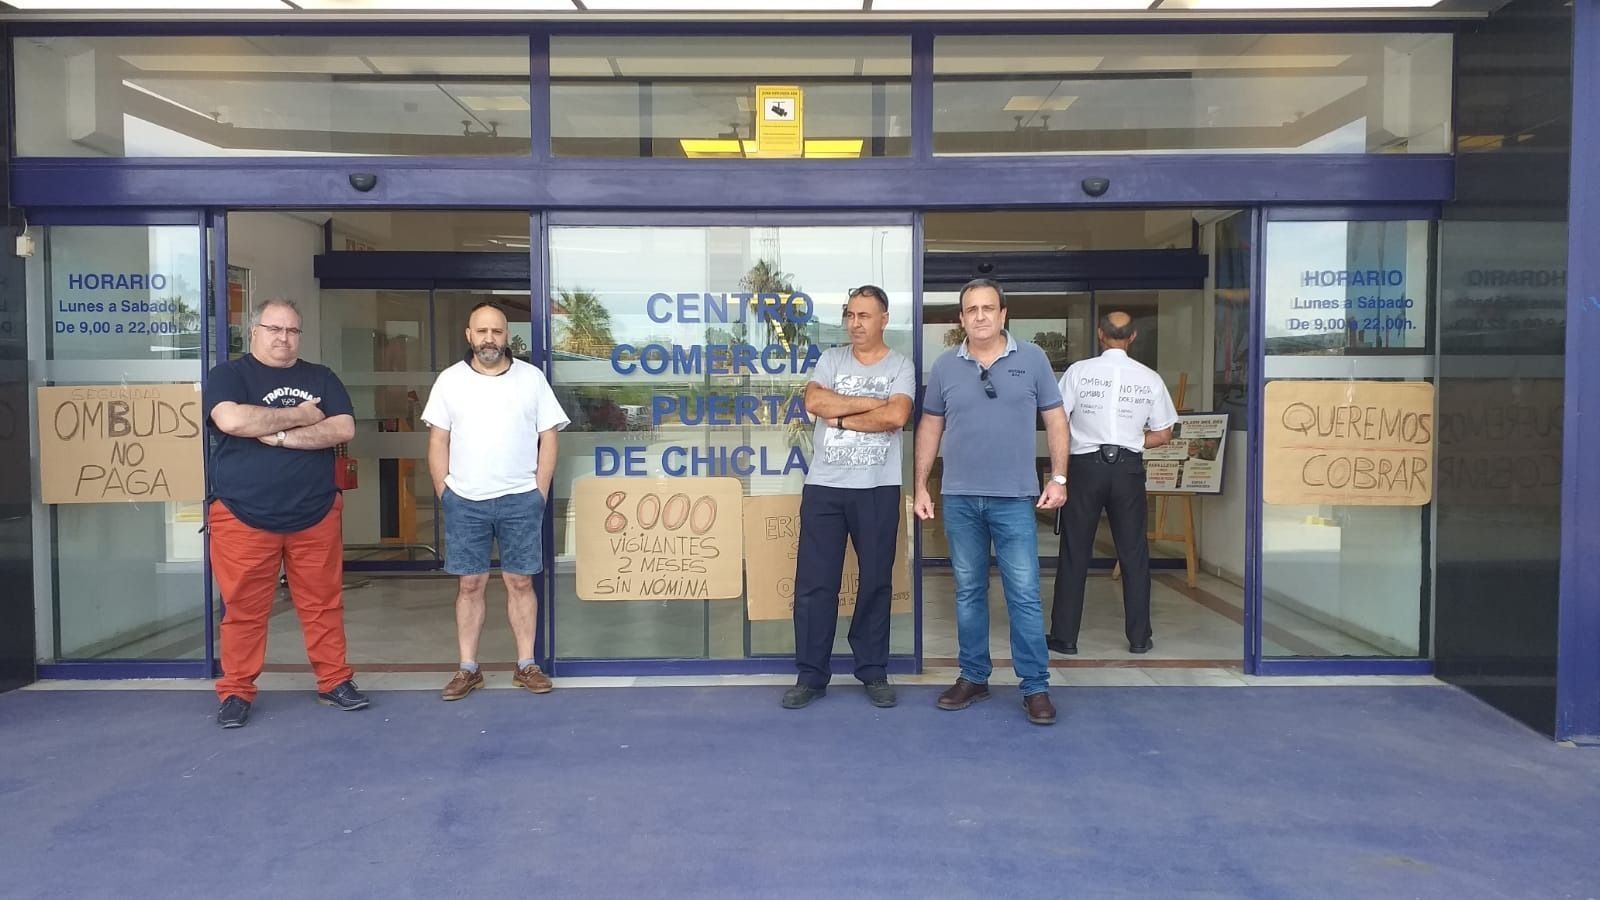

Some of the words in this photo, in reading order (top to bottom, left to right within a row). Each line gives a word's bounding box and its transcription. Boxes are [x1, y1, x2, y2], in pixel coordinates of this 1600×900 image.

[69, 273, 167, 290] HORARIO
[1304, 269, 1404, 287] HORARIO
[59, 300, 104, 313] Lunes
[108, 303, 118, 313] a
[646, 292, 815, 324] CENTRO
[1294, 296, 1340, 310] Lunes
[1343, 299, 1353, 310] a
[1357, 294, 1414, 310] Sábado
[55, 321, 76, 334] De
[79, 321, 111, 336] 9,00
[115, 324, 124, 334] a
[1290, 317, 1311, 331] De
[1313, 317, 1346, 332] 9,00
[1363, 317, 1417, 332] 22,00h.
[611, 343, 822, 375] COMERCIA
[72, 386, 162, 401] SEGURIDAD
[1119, 384, 1132, 394] NO
[54, 399, 200, 441] OMBUDS
[652, 396, 811, 426] PUERTA
[1281, 402, 1432, 445] QUEREMOS
[111, 441, 145, 468] NO
[595, 446, 647, 476] DE
[662, 446, 810, 476] CHICLA
[75, 464, 171, 497] PAGA
[1301, 454, 1428, 493] COBRAR
[604, 491, 718, 535] 8.000
[617, 557, 633, 574] 2
[640, 557, 707, 574] MESES
